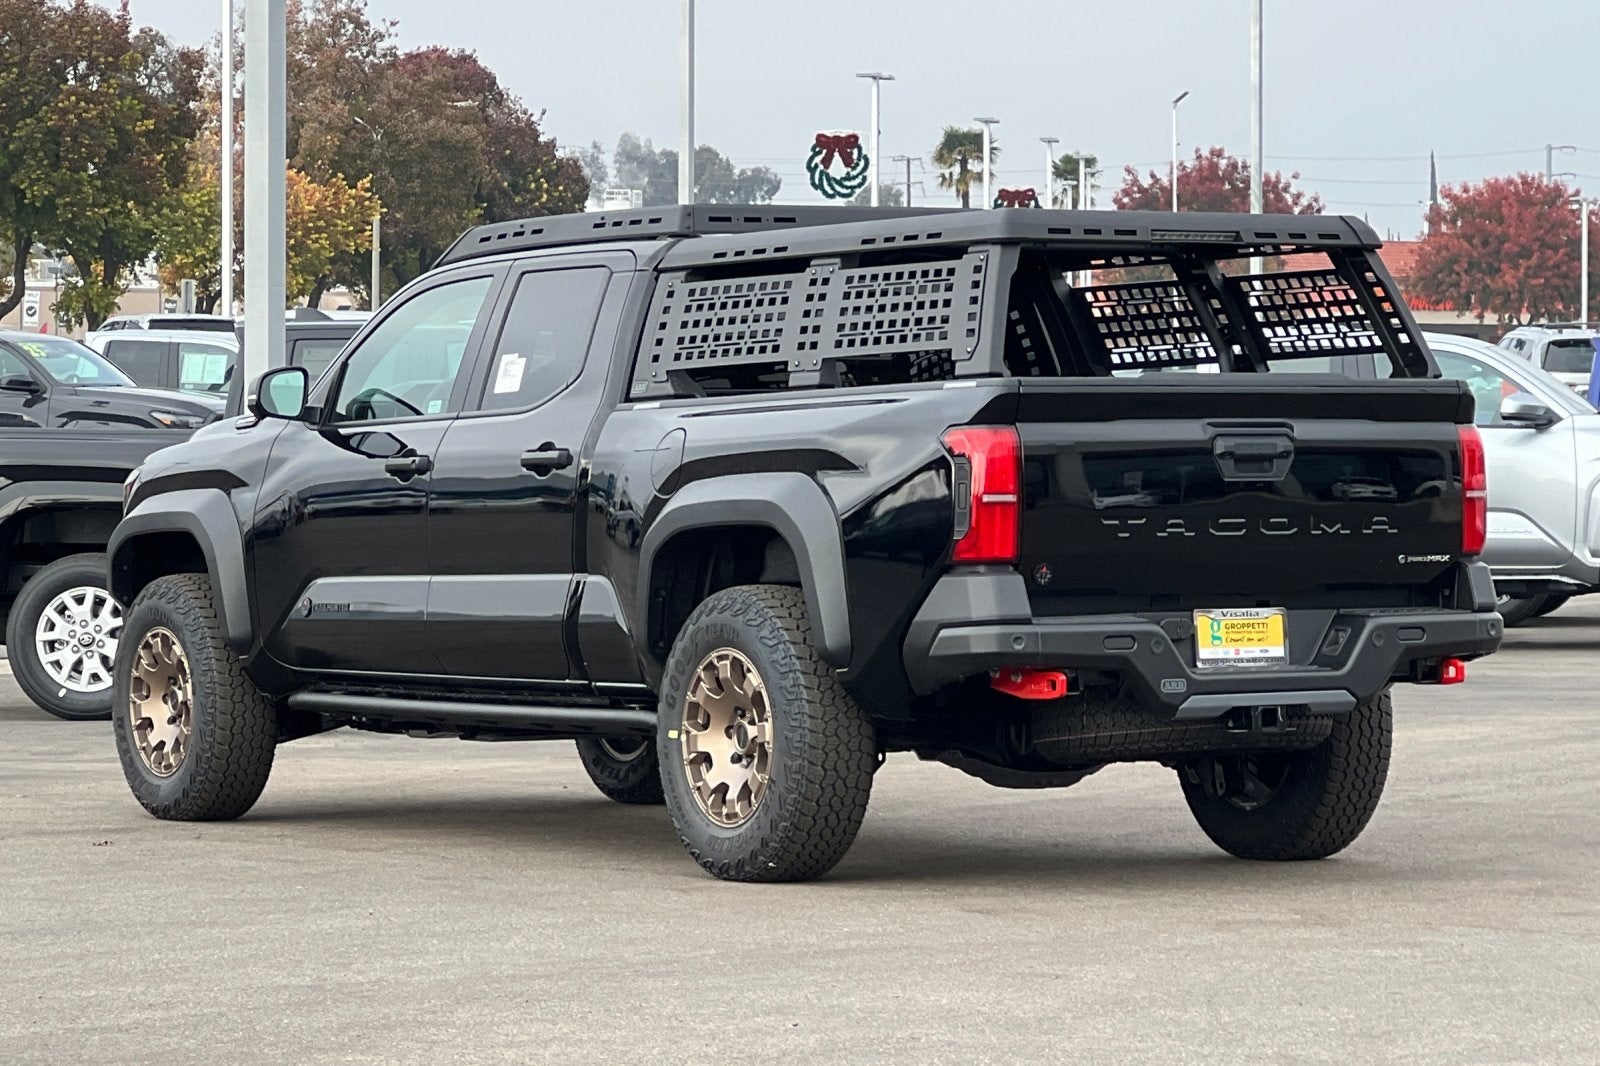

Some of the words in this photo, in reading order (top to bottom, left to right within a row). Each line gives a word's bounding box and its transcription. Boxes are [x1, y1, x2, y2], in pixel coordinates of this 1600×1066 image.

[1101, 516, 1398, 538] TACOMA
[1220, 610, 1260, 618] Visalia
[1224, 622, 1269, 631] GROPPETTI
